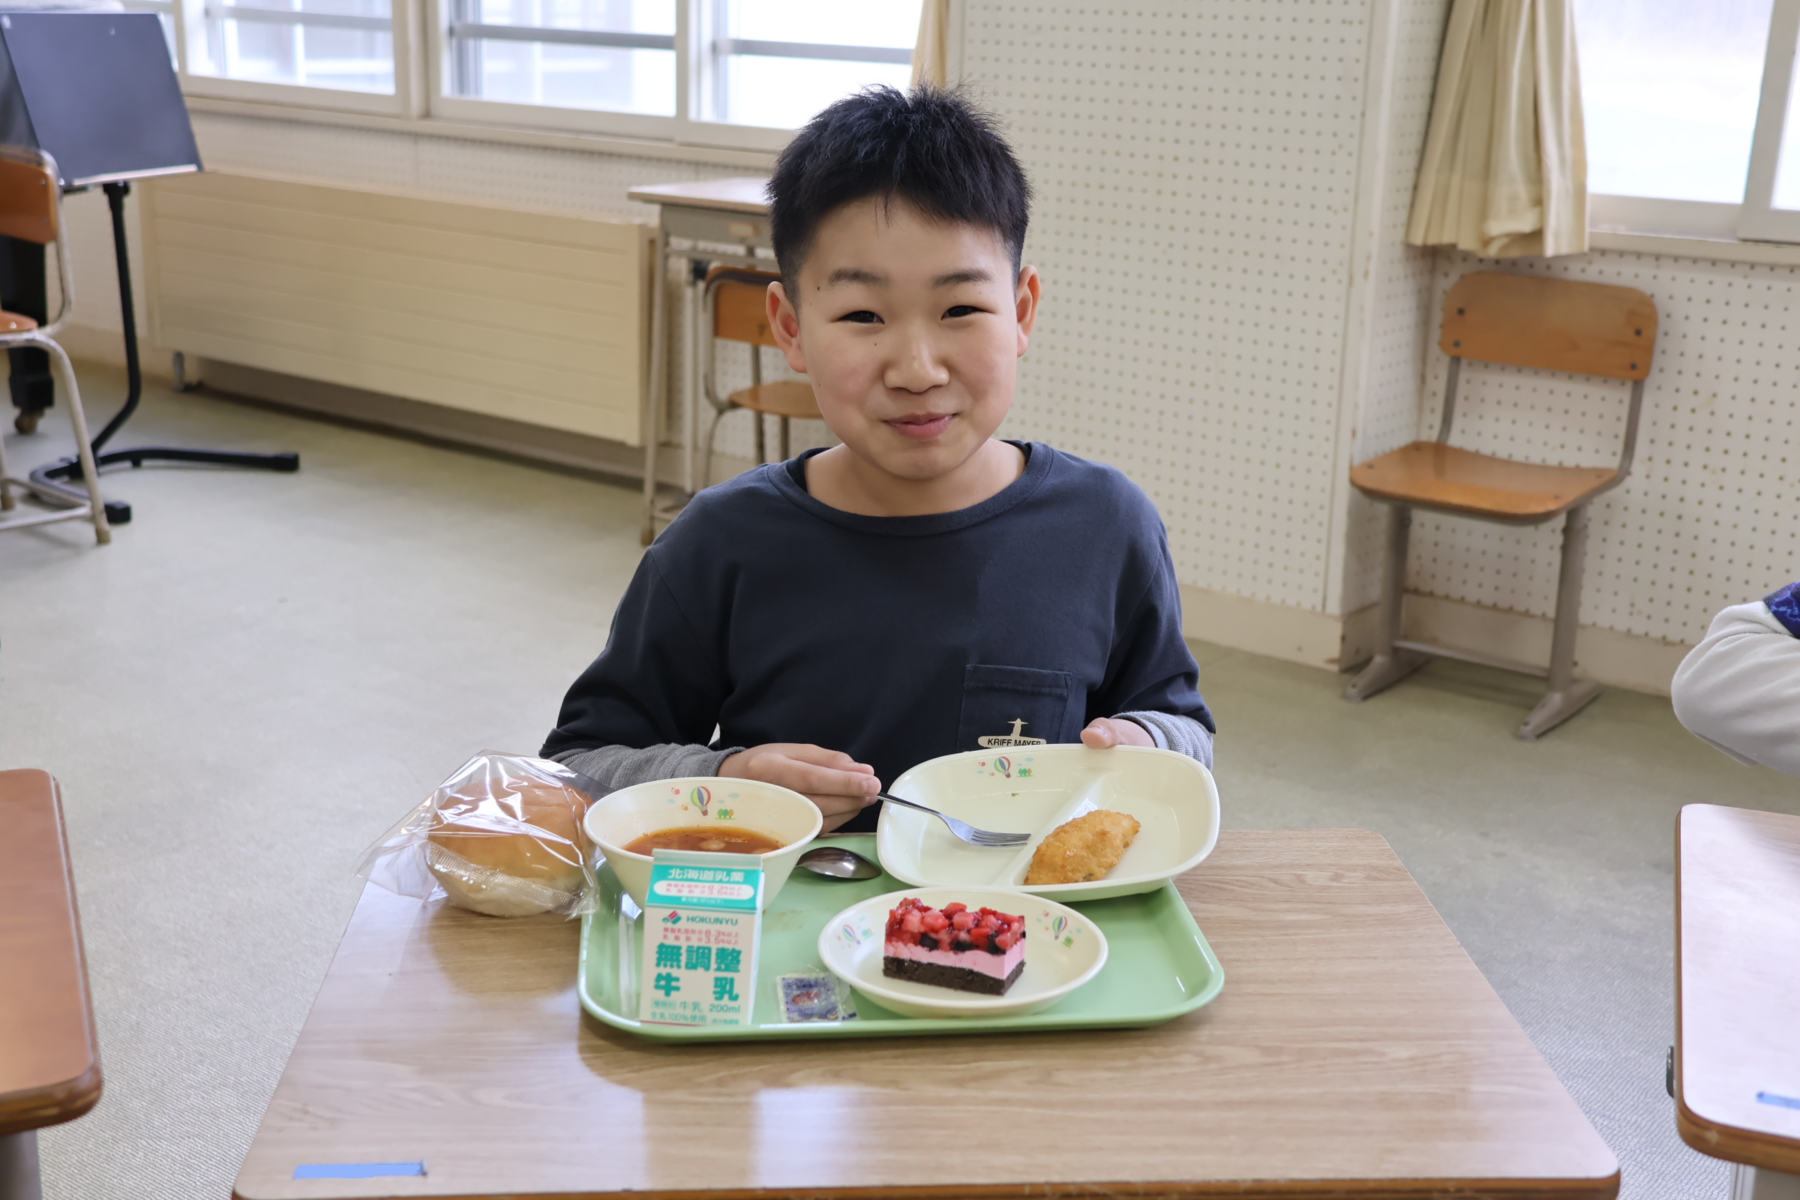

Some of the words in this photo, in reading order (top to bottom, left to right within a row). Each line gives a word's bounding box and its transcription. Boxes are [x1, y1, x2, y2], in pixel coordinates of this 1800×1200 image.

[987, 738, 1012, 747] KRIFF
[667, 868, 745, 882] 北海道乳業
[686, 915, 738, 926] HOKUNYU
[655, 942, 742, 973] 無調整
[679, 1001, 703, 1013] 牛乳
[709, 1004, 741, 1013] 200ml
